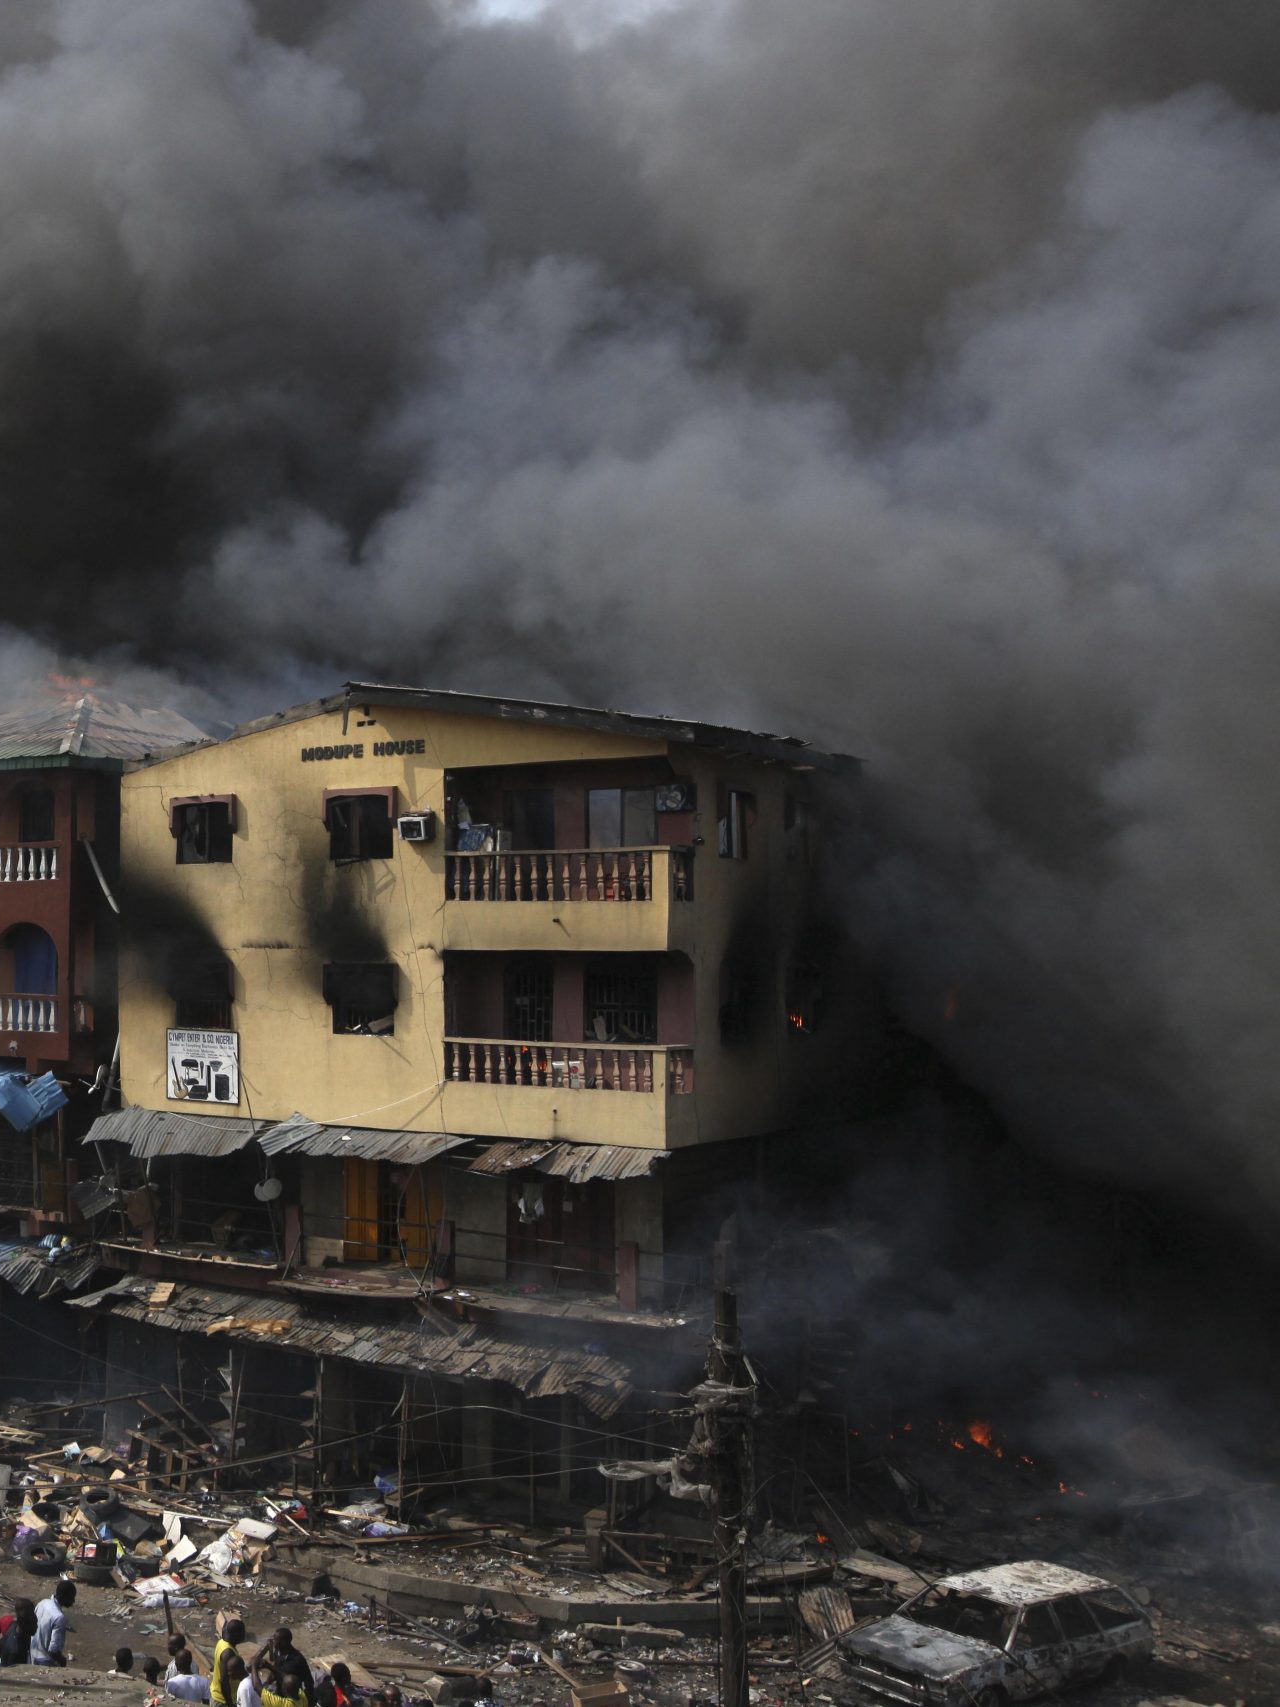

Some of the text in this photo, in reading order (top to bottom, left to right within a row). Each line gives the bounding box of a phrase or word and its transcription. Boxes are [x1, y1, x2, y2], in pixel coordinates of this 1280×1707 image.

[301, 740, 425, 761] MODUPE HOUSE
[216, 1035, 233, 1044] NIGERIA
